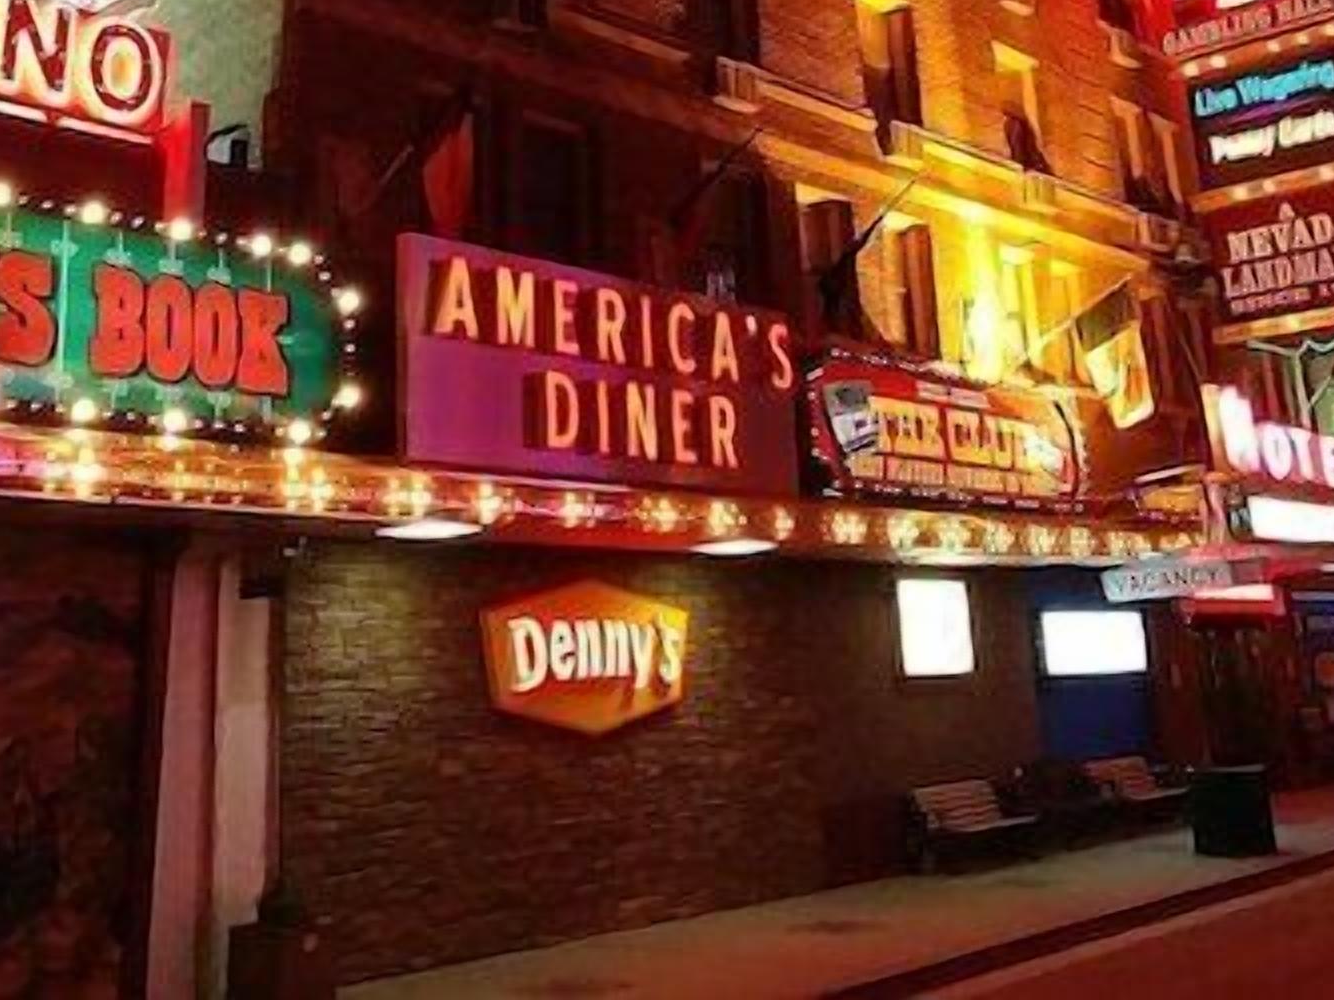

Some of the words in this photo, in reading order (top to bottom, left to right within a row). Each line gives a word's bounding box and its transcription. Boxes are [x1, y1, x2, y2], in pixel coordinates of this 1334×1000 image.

[1163, 8, 1271, 56] GAMBLING
[1278, 202, 1296, 222] A
[90, 265, 293, 398] BOOK
[434, 256, 794, 393] AMERICA'S
[545, 370, 741, 469] DINER
[1109, 567, 1221, 593] VACANCY
[507, 610, 682, 693] Denny's
